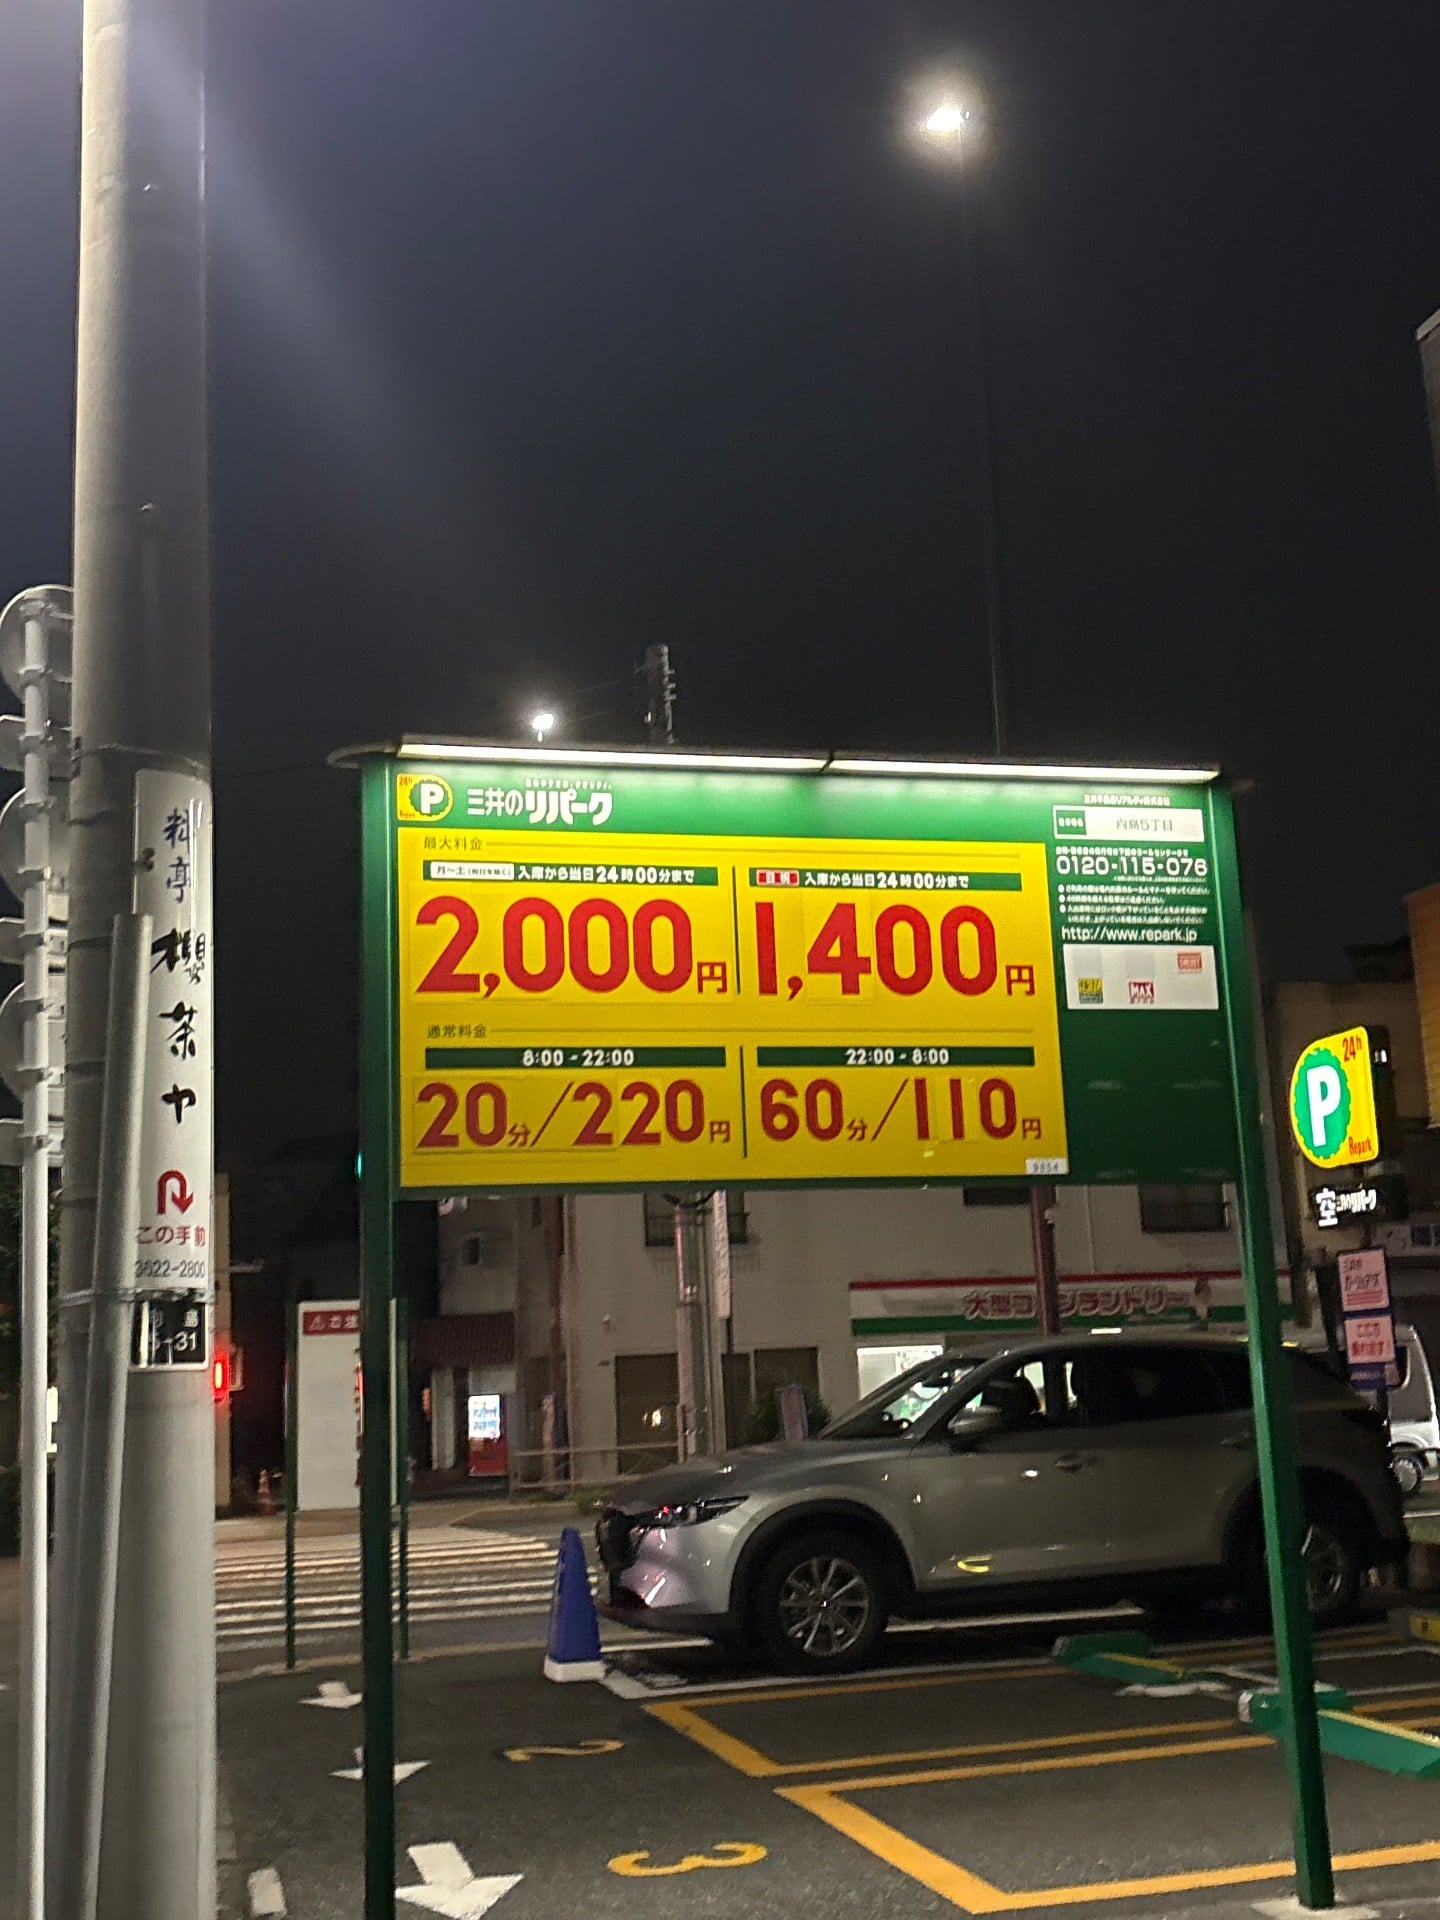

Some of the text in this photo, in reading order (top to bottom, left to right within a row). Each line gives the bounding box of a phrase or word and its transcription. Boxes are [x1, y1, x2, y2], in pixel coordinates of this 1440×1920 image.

[420, 783, 444, 814] P
[466, 786, 613, 825] 三井のリパーク
[423, 836, 483, 852] 最大料金
[416, 895, 728, 998] 2,000円
[1061, 926, 1198, 943] http://www.repark.jp
[755, 901, 1035, 1000] 1,400円
[426, 1024, 487, 1039] 通常料金
[1342, 1035, 1362, 1061] 24h
[1306, 1065, 1341, 1147] P
[1348, 1136, 1372, 1157] Repark
[1315, 1187, 1338, 1227] 空
[135, 1225, 206, 1248] この手前
[607, 1840, 769, 1877] 3
